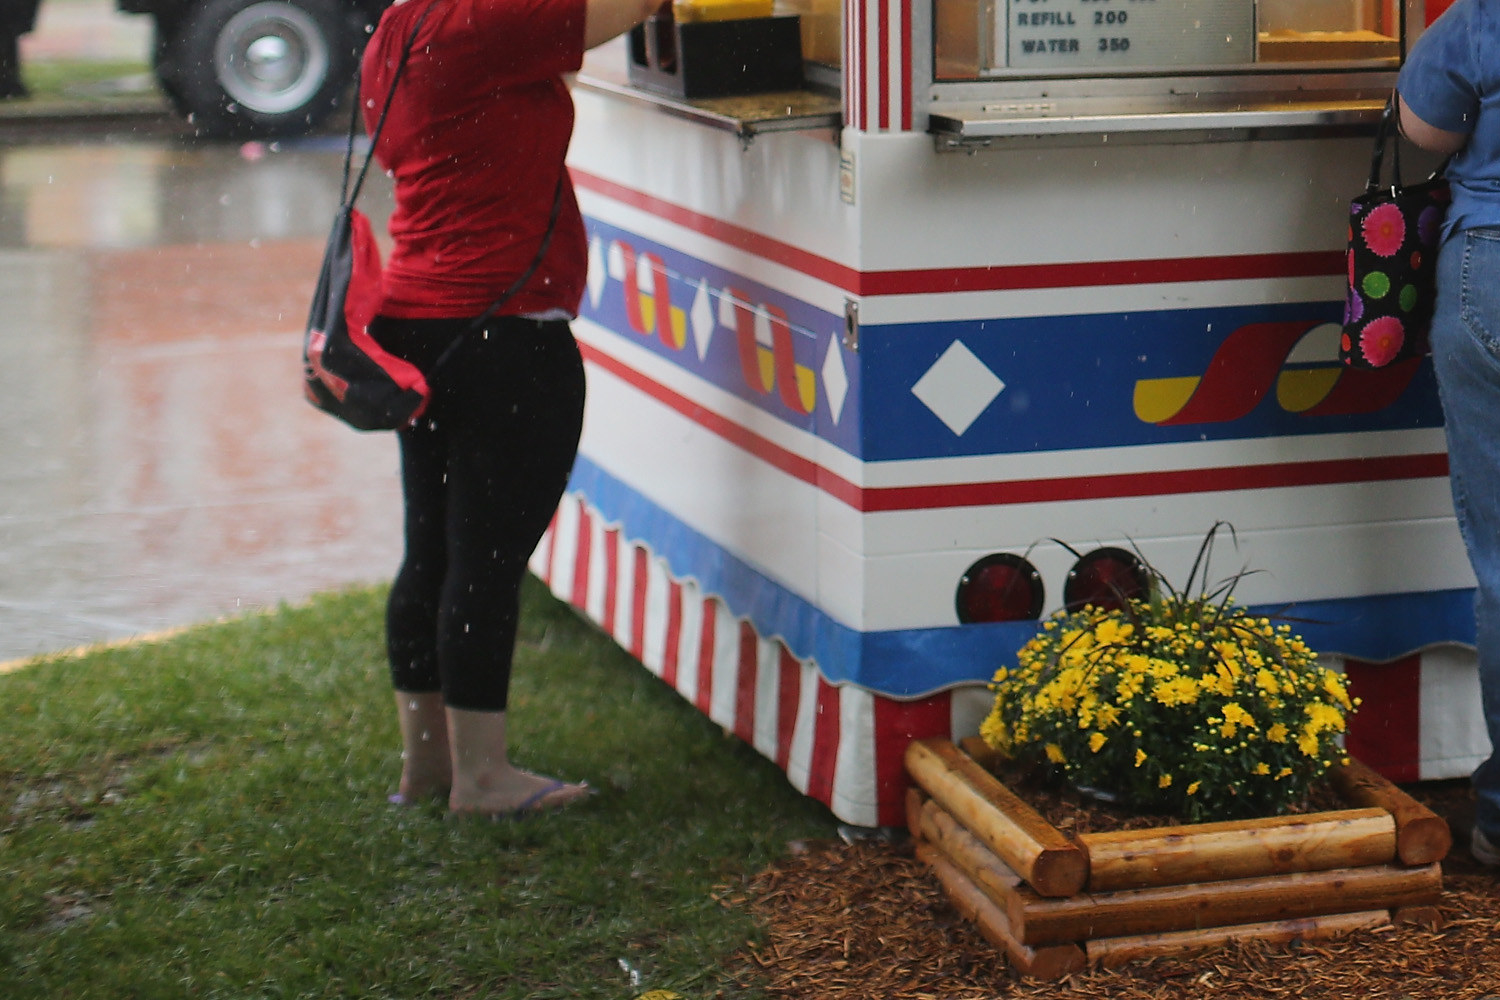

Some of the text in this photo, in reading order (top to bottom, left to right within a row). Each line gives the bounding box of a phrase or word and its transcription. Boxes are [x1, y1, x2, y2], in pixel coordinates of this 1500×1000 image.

[1017, 10, 1129, 26] REFILL 200
[1021, 37, 1131, 53] WATER 350
